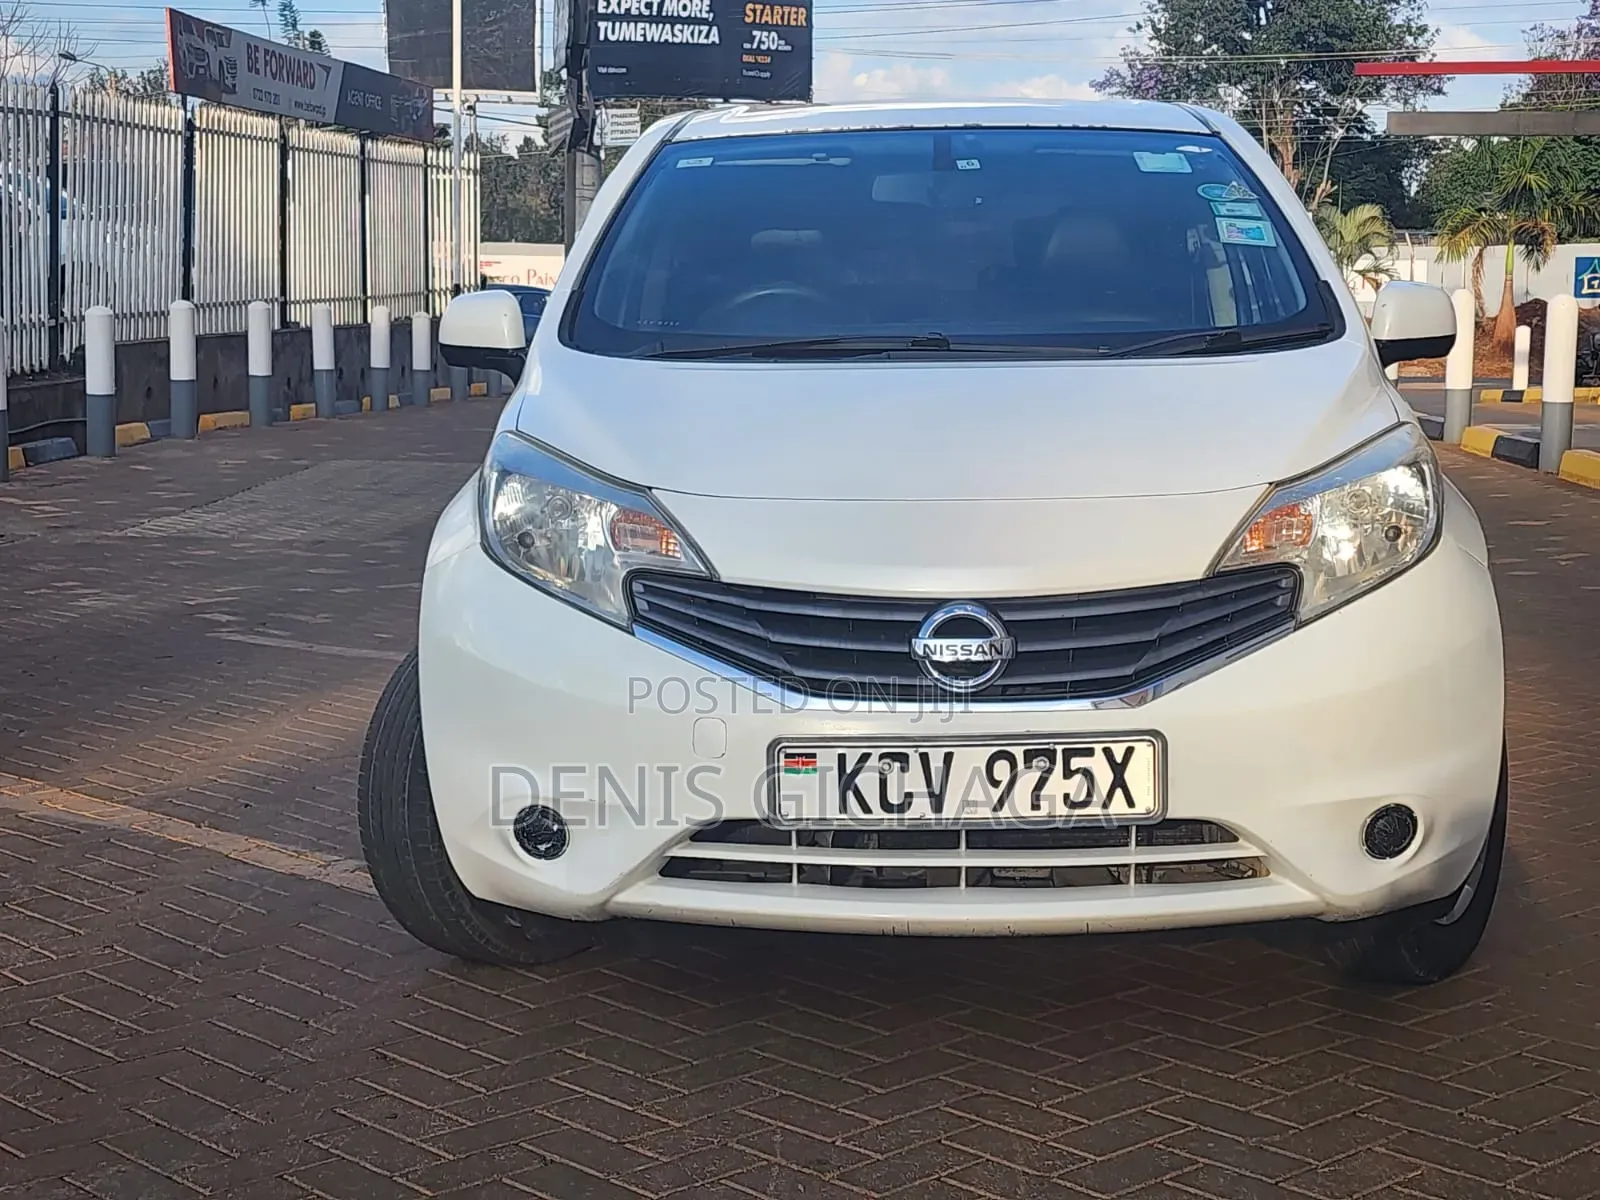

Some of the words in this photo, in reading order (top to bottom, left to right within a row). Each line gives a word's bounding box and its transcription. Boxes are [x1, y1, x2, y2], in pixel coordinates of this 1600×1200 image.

[597, 0, 660, 15] EXPECT
[662, 0, 715, 21] MORE,
[744, 3, 807, 27] STARTER
[597, 21, 720, 44] TUMEWASKIZA
[752, 30, 779, 50] 750
[246, 42, 260, 75] BE
[263, 48, 316, 90] FORWARD
[922, 641, 1004, 657] NISSAN
[837, 750, 955, 815] KCV
[984, 745, 1136, 814] 975X
